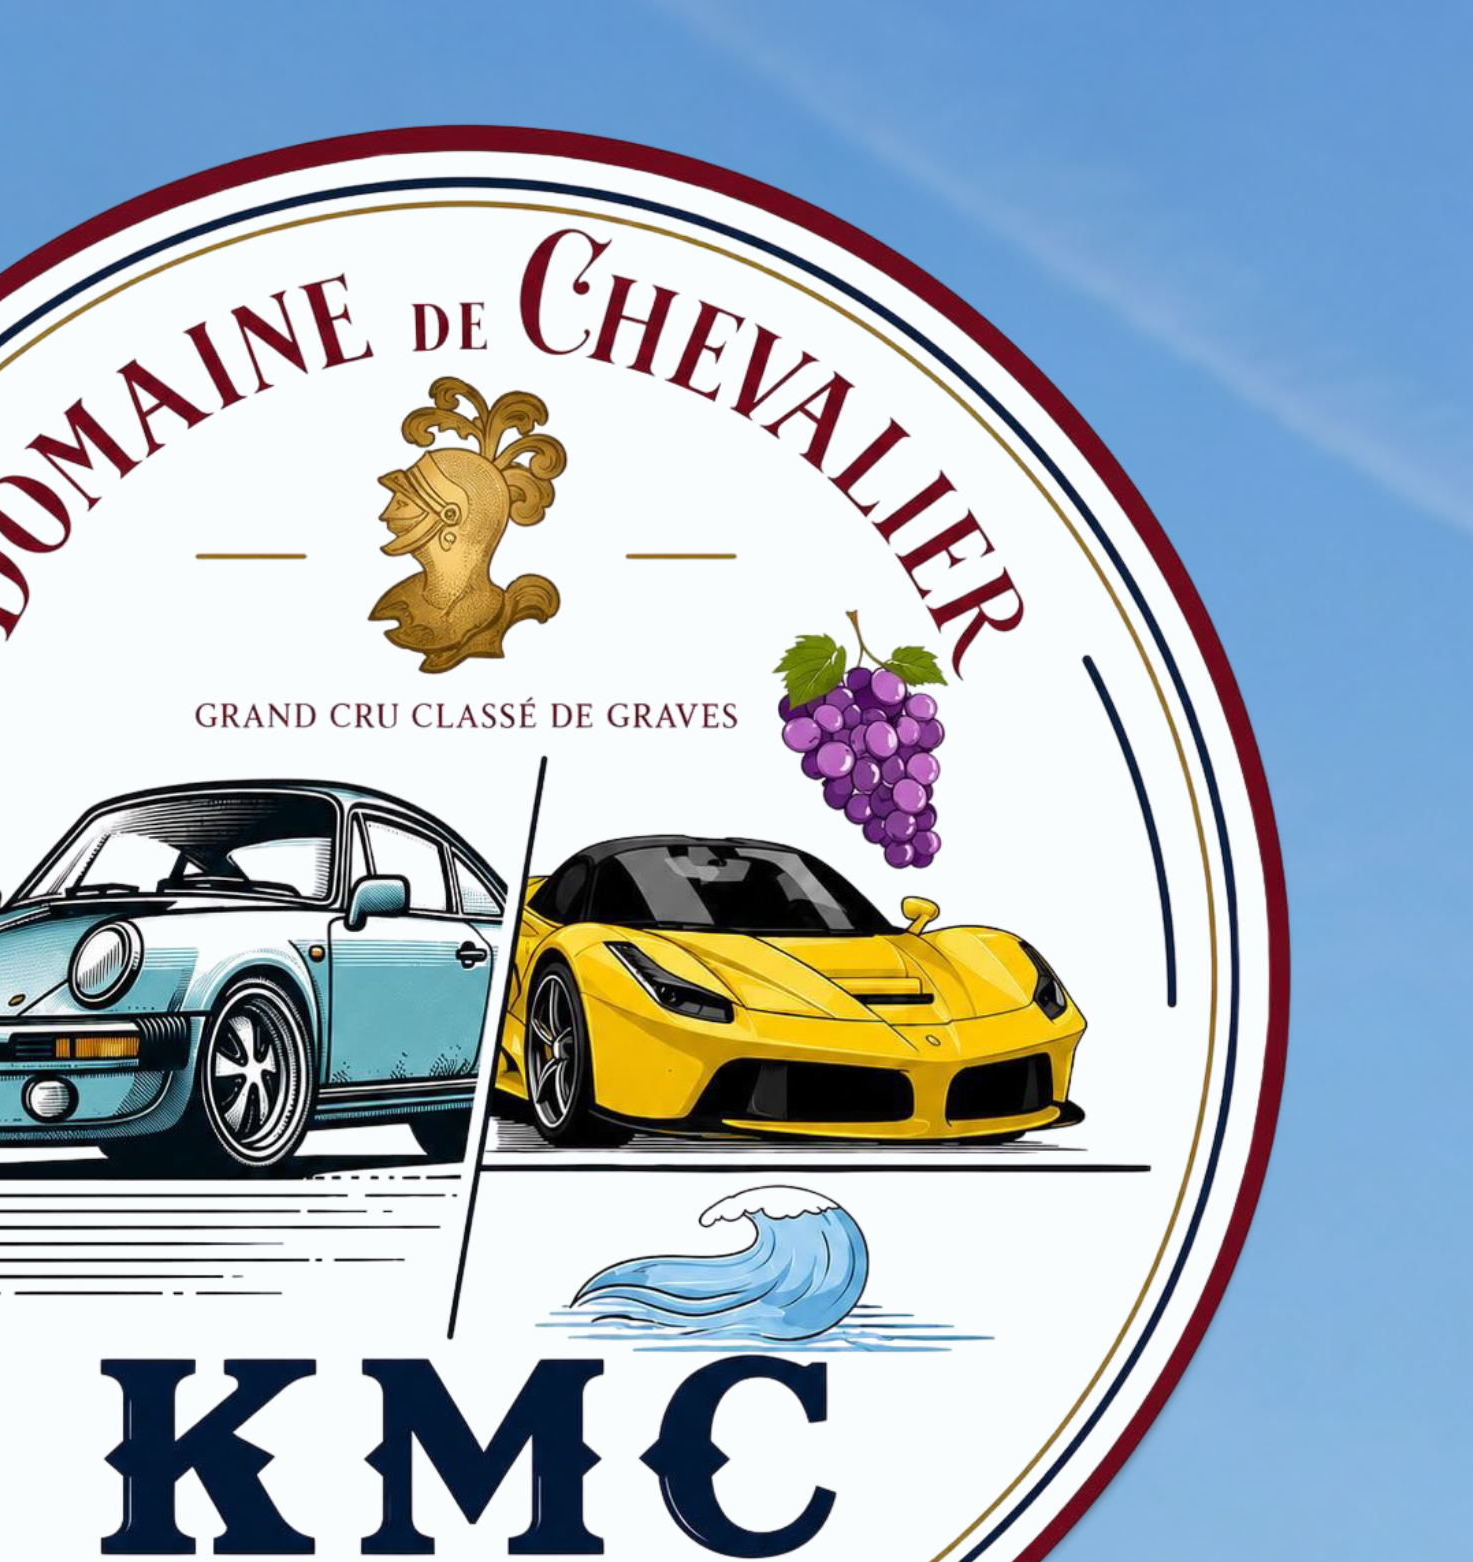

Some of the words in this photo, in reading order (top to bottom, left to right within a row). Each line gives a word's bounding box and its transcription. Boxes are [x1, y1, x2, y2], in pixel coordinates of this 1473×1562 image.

[411, 302, 489, 352] DE
[518, 228, 1026, 680] CHEVALIER
[195, 702, 317, 729] GRAND
[330, 702, 399, 729] CRU
[411, 697, 536, 729] CLASSÉ
[551, 703, 593, 729] DE
[607, 703, 738, 729] GRAVES
[98, 1355, 838, 1559] KMC
